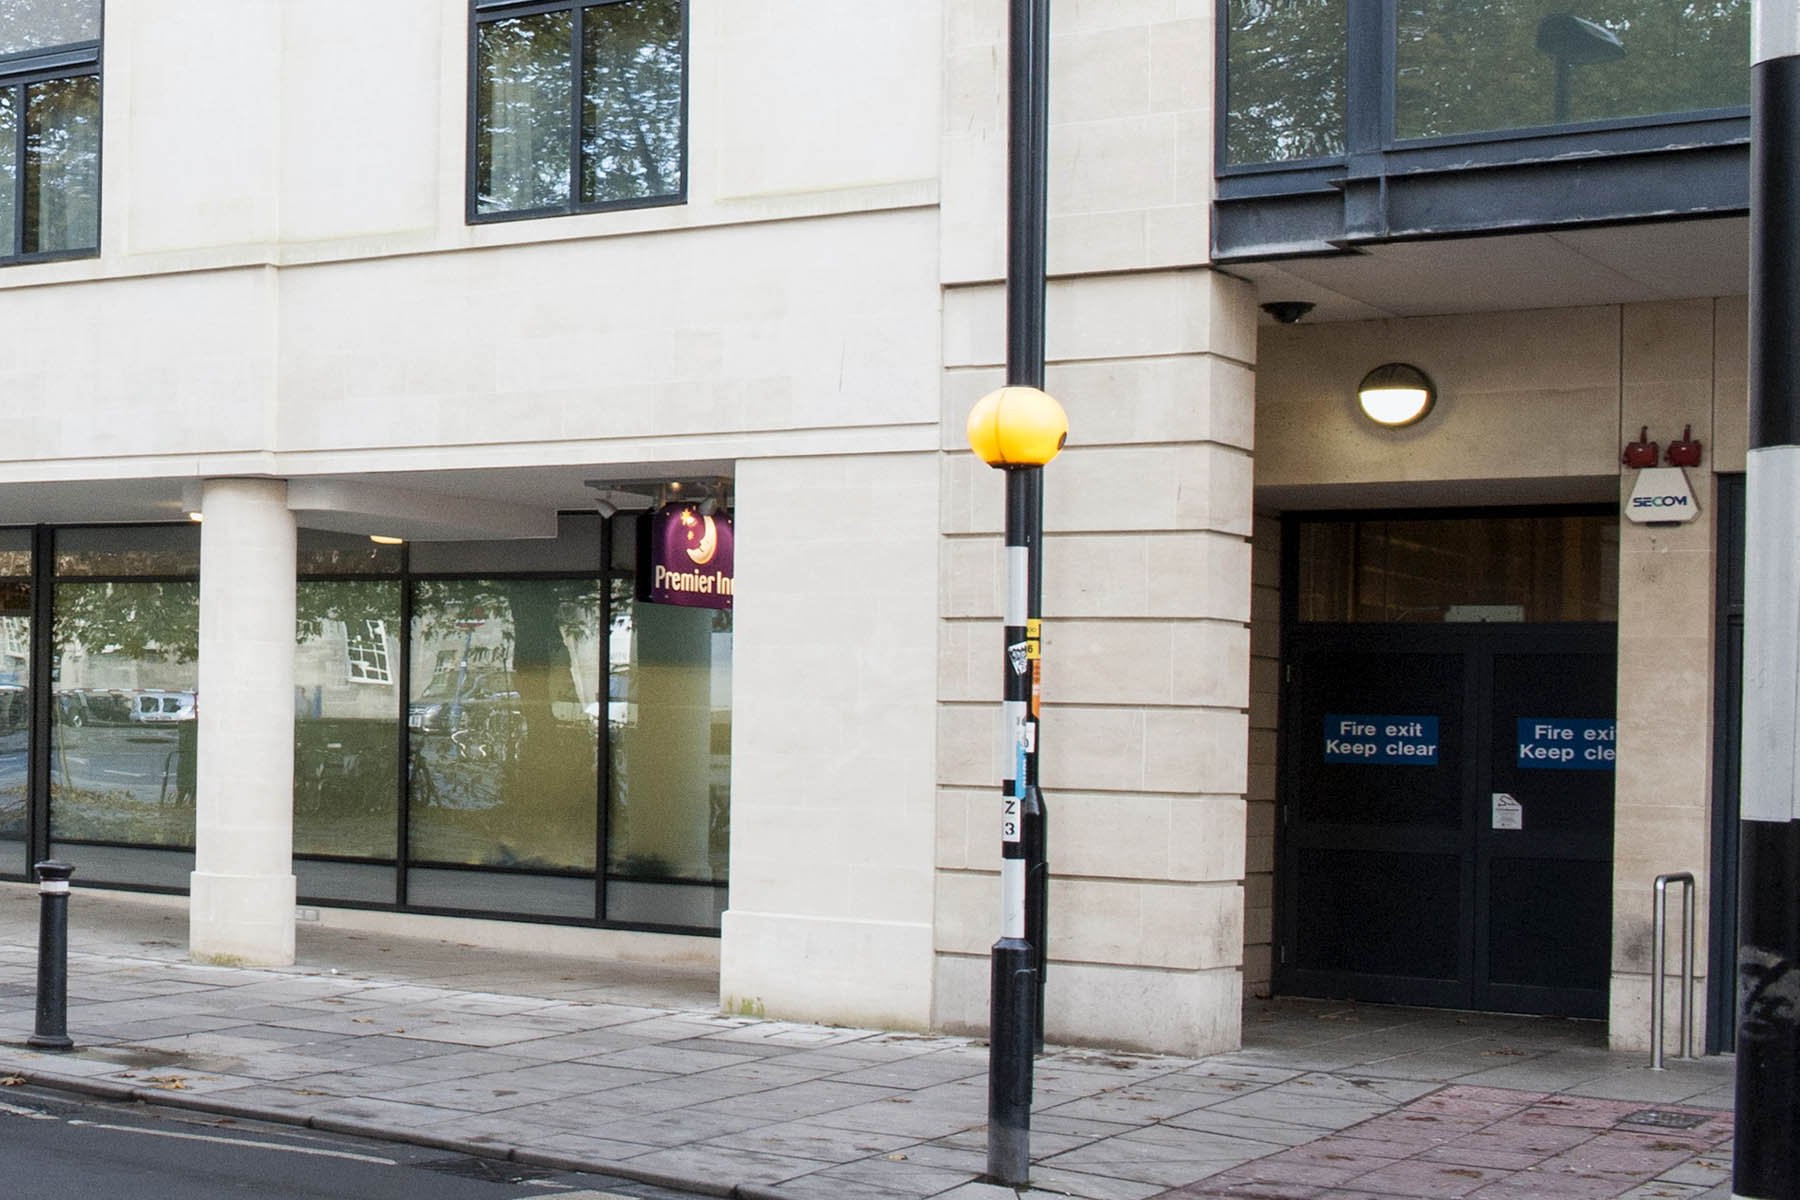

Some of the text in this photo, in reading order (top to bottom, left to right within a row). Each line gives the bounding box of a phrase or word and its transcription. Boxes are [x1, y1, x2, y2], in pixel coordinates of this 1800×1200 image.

[1633, 496, 1687, 507] SECOM
[655, 564, 715, 593] Premier
[1340, 721, 1423, 737] Fire exit
[1535, 725, 1616, 741] Fire exi
[1326, 739, 1437, 758] Keep clear
[1520, 743, 1616, 762] Keep cle
[1004, 800, 1016, 815] Z
[1004, 821, 1016, 836] 3
